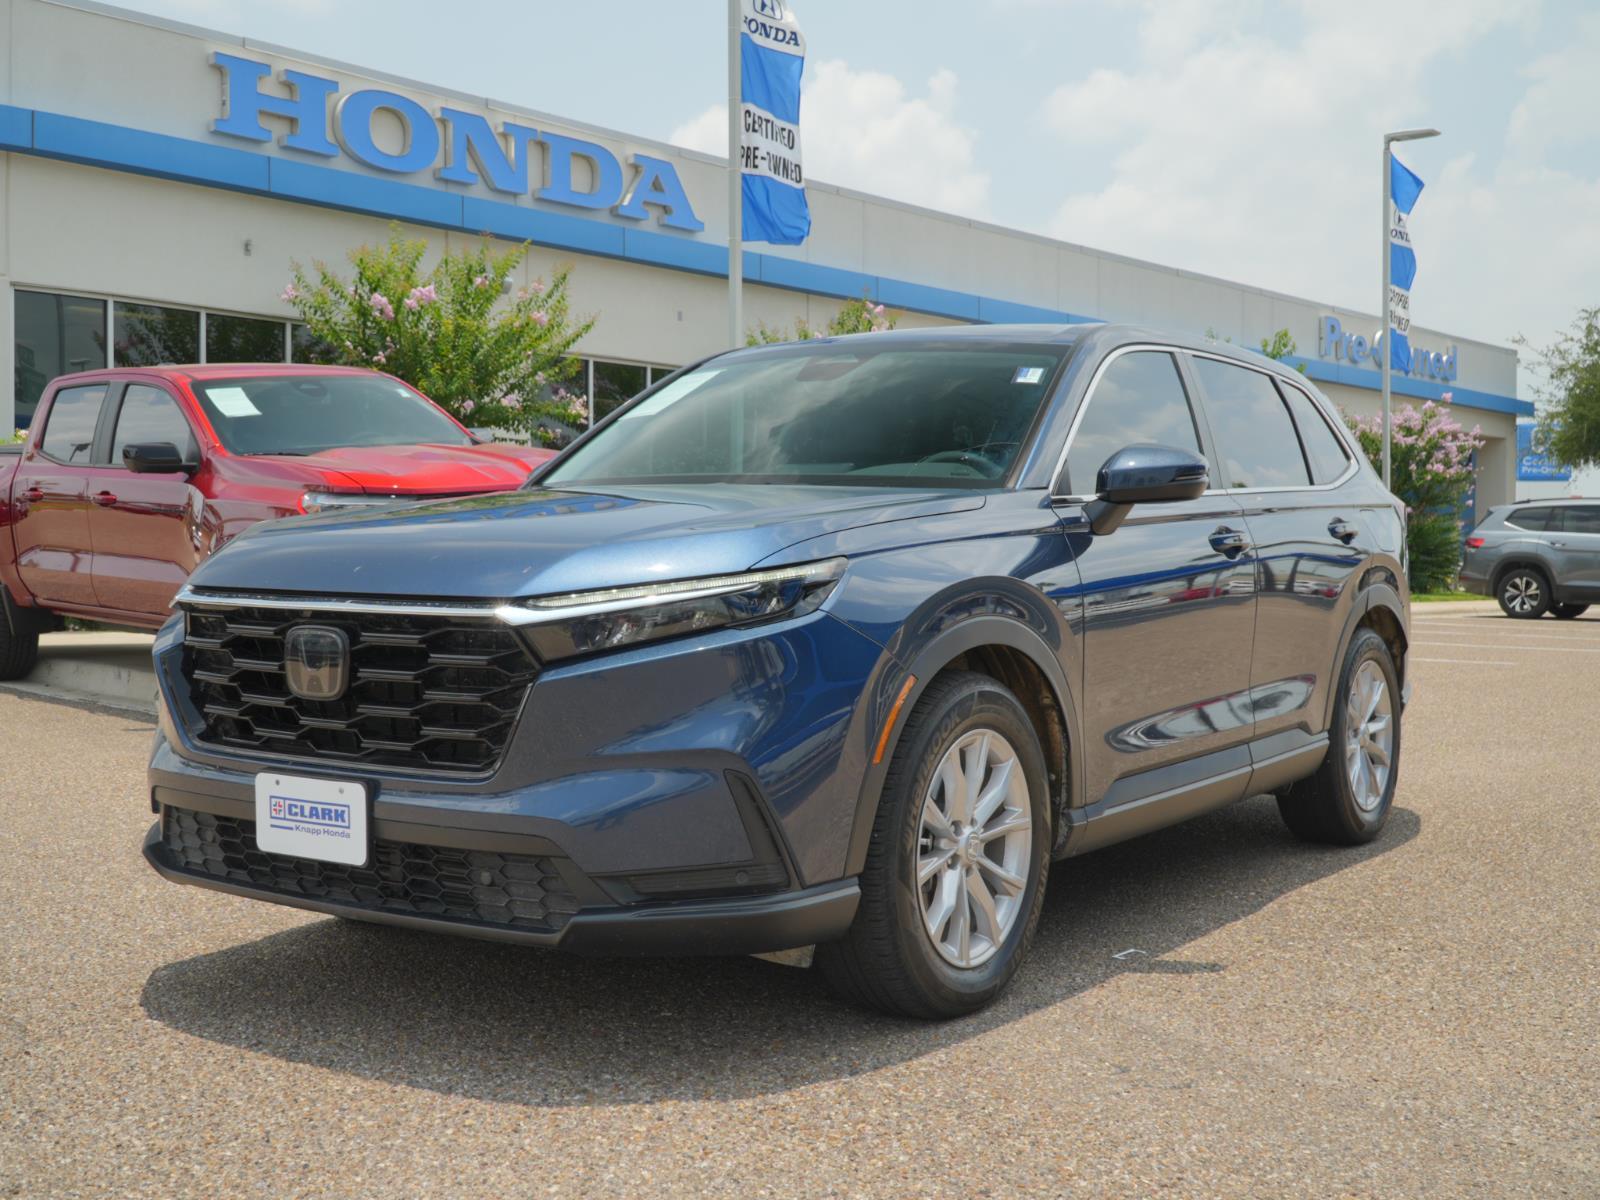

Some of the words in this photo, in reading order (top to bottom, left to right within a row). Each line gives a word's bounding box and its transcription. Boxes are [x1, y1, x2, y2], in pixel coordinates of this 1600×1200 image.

[208, 51, 705, 232] HONDA
[1319, 316, 1457, 381] Pre-ned
[287, 803, 346, 823] CLARK
[294, 824, 322, 836] Knapp
[322, 828, 351, 839] Honda
